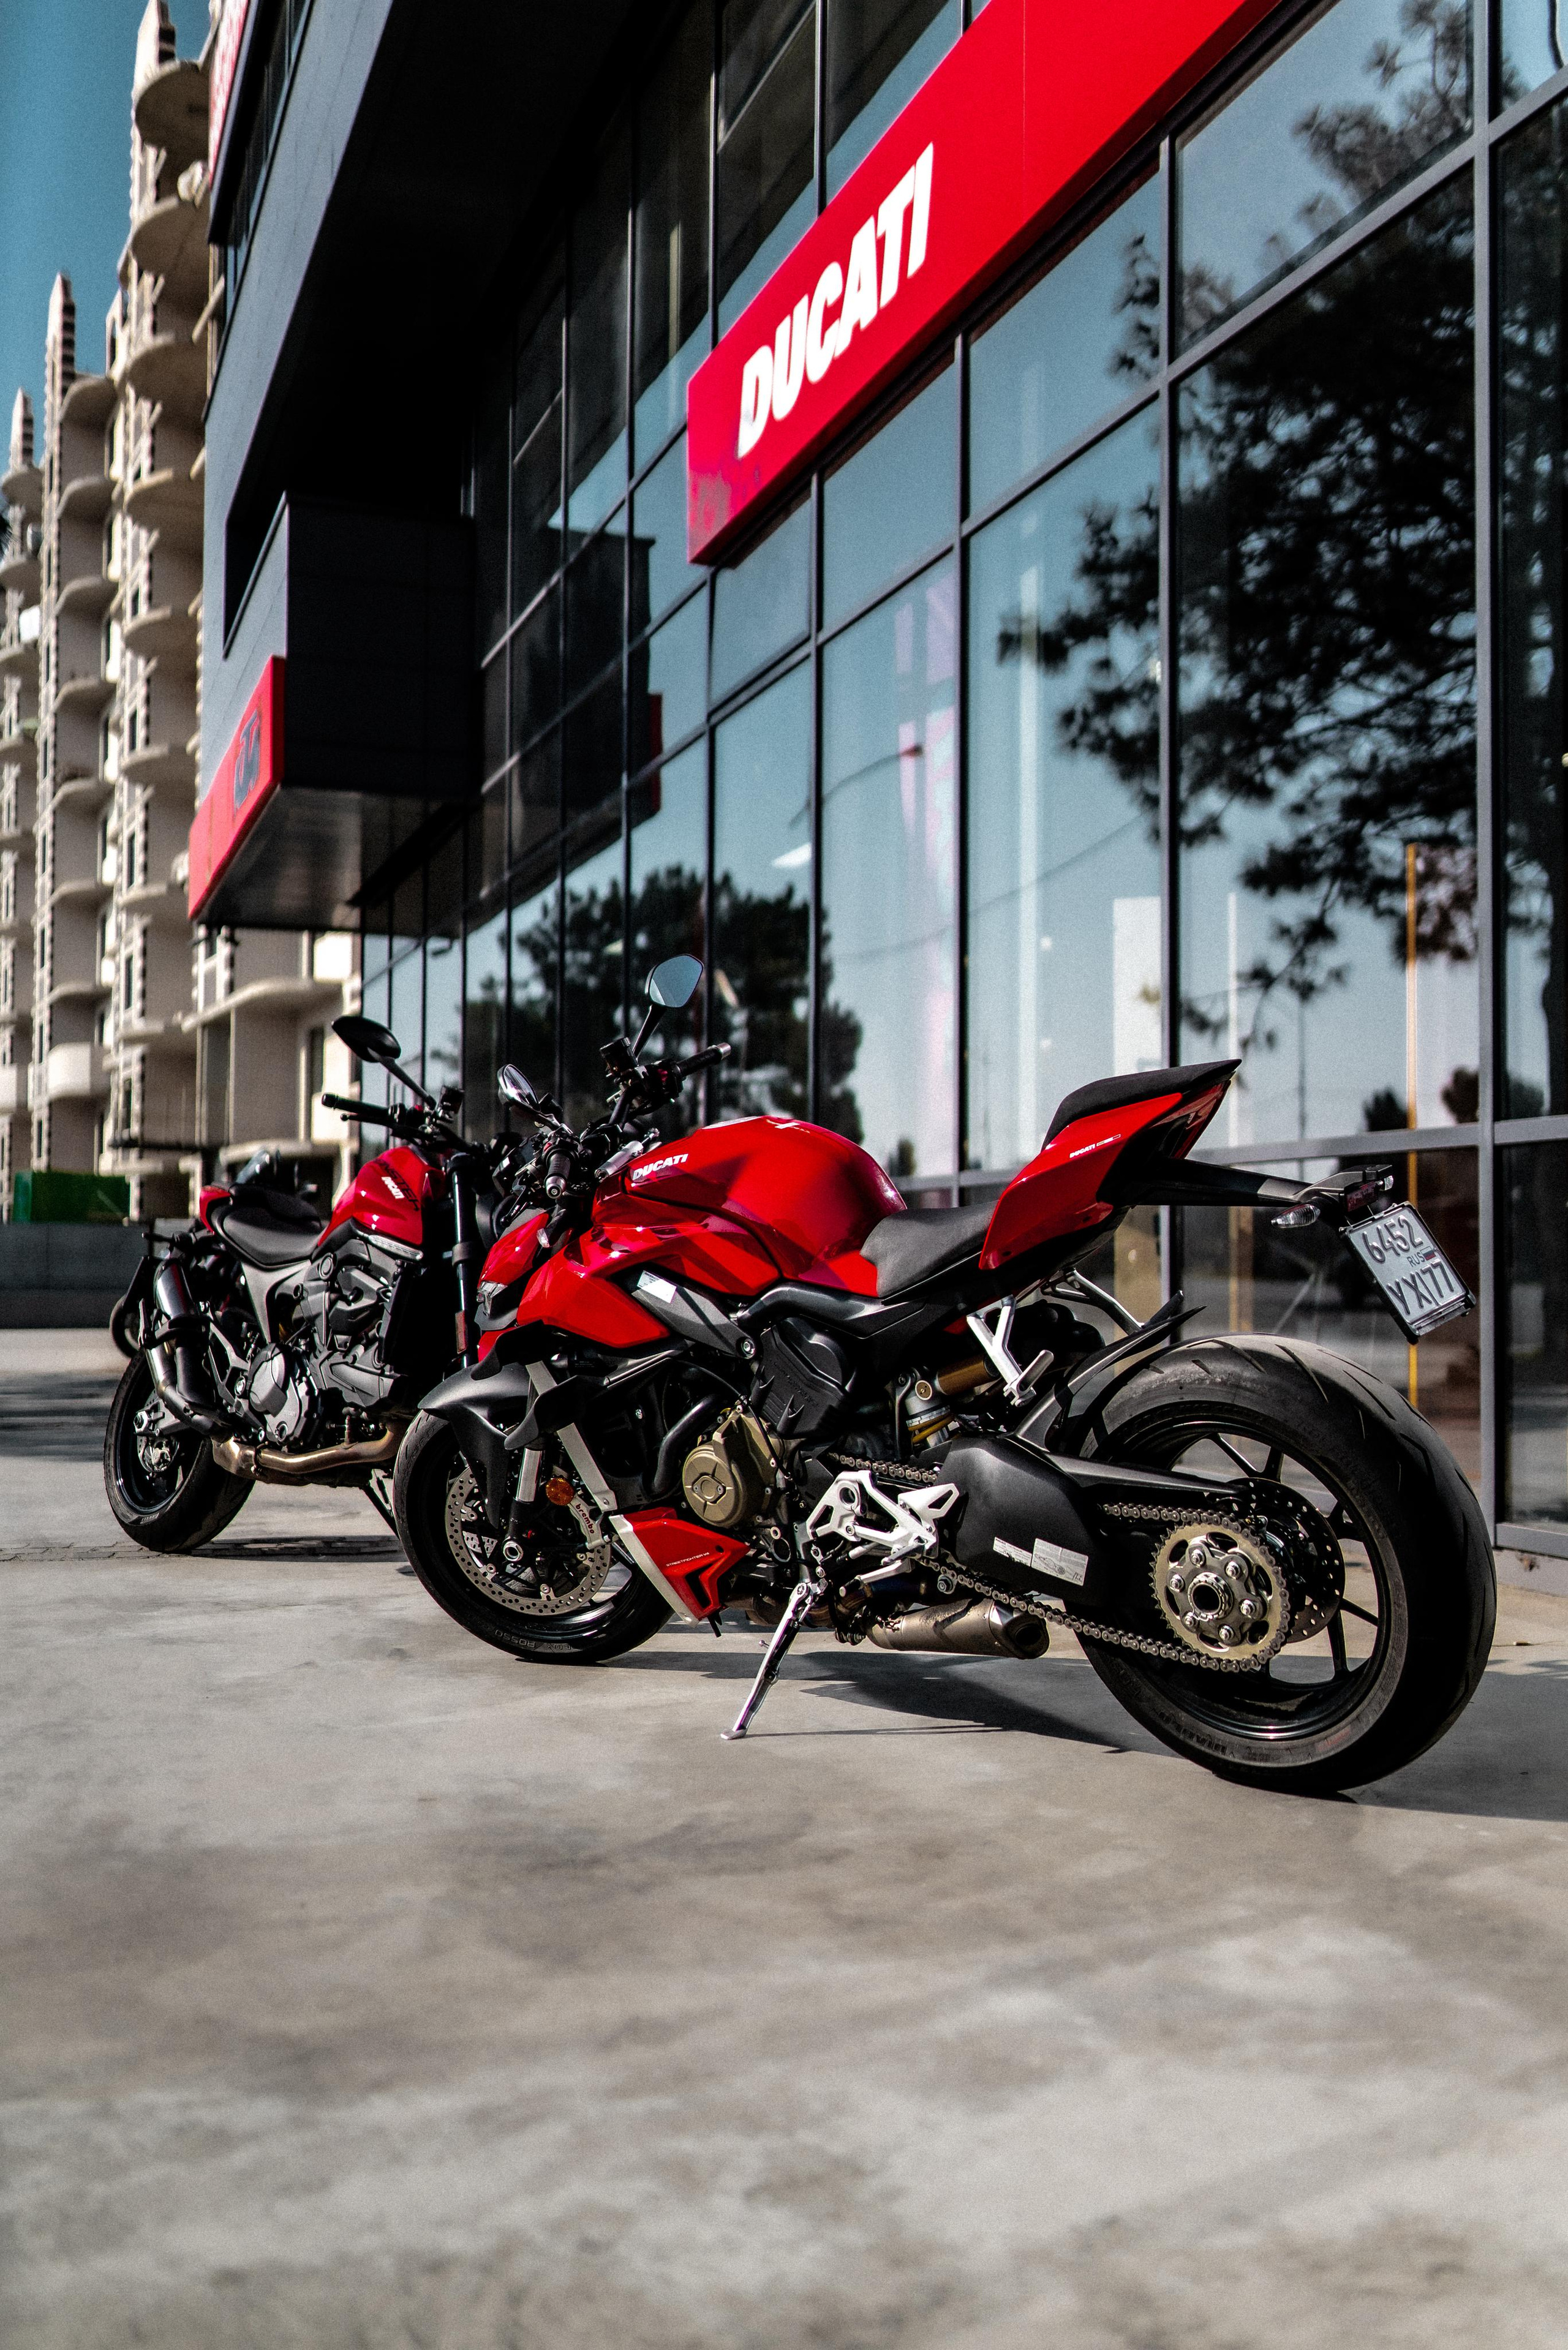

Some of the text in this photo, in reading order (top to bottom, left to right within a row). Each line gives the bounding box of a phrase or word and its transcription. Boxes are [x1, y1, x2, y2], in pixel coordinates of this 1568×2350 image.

[737, 142, 933, 459] DUCATI
[1069, 1144, 1095, 1158] DUCATI
[633, 1154, 688, 1180] DUCATI
[382, 1177, 404, 1199] DUCATI
[1362, 1215, 1423, 1264] 6452
[1407, 1252, 1425, 1267] RUS
[576, 1504, 594, 1534] brembo
[495, 1629, 535, 1648] ROSSO
